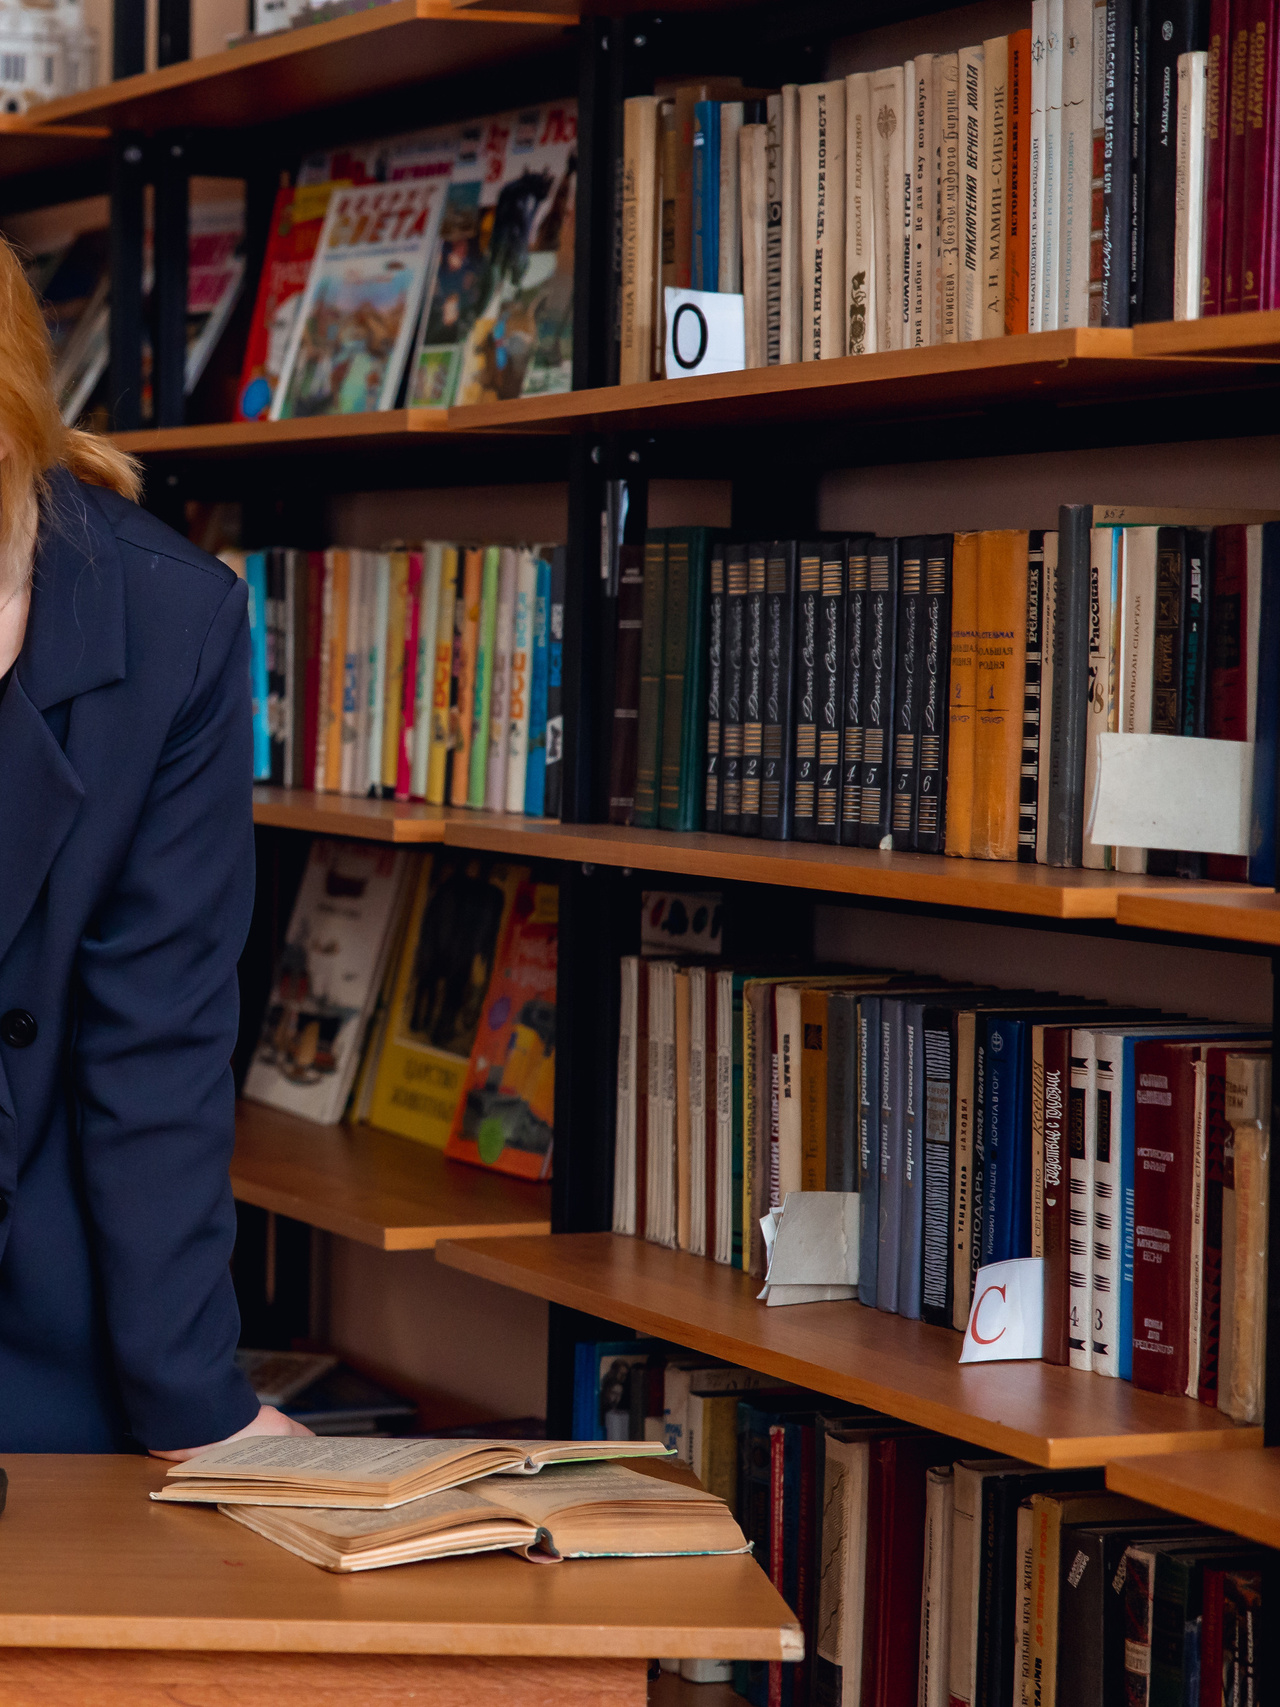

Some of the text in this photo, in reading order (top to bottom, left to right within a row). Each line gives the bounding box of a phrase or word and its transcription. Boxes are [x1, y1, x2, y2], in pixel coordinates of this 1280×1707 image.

[1161, 66, 1171, 133] МАКАРЕНКО
[1105, 114, 1114, 159] ОХОТА
[854, 114, 863, 257] НИКОЛАЙ ЕВДОКИМОВ
[965, 62, 980, 272] ПРИКЛЮЧЕНИЯ ВЕРНЕРА ХОЛЬТА
[989, 83, 1006, 262] МАМИН-СИБИРЯК
[1010, 120, 1019, 237] ИСТОРИЧЕСКИЕ
[816, 172, 825, 240] ЧЕТЫРЕ
[903, 173, 912, 324] СЛОМАННЫЕ СТРЕЛЫ
[813, 247, 824, 361] АВЕЛ НИЛИН
[1028, 568, 1040, 644] РЕМАРК
[1132, 594, 1142, 650] СПАРТАК
[978, 646, 1014, 656] ОЛЬШАЯ
[707, 757, 717, 774] 1
[727, 760, 738, 777] 2
[746, 760, 757, 776] 2
[766, 761, 776, 778] 3
[801, 761, 812, 778] 3
[823, 768, 834, 786] 4
[847, 765, 857, 782] 4
[866, 768, 877, 784] 5
[898, 773, 909, 790] 5
[923, 776, 933, 793] 6
[991, 1068, 1000, 1095] ГОРУ
[991, 1104, 999, 1147] ДОРОГА
[1032, 1059, 1043, 1238] СЕРГИЕНКО КСЕНИЯ
[1194, 1111, 1204, 1226] ВЕЧНЫЕ СТРАННИКИ
[958, 1165, 967, 1233] ТЕНДРЯКОВ
[987, 1163, 997, 1255] Михаил БАРЫШЕВ
[971, 1283, 1008, 1345] С
[1069, 1305, 1080, 1328] 4
[1094, 1308, 1104, 1331] 3
[1023, 1547, 1033, 1591] ЖИЗНЬ
[1022, 1596, 1032, 1624] ЧЕМ
